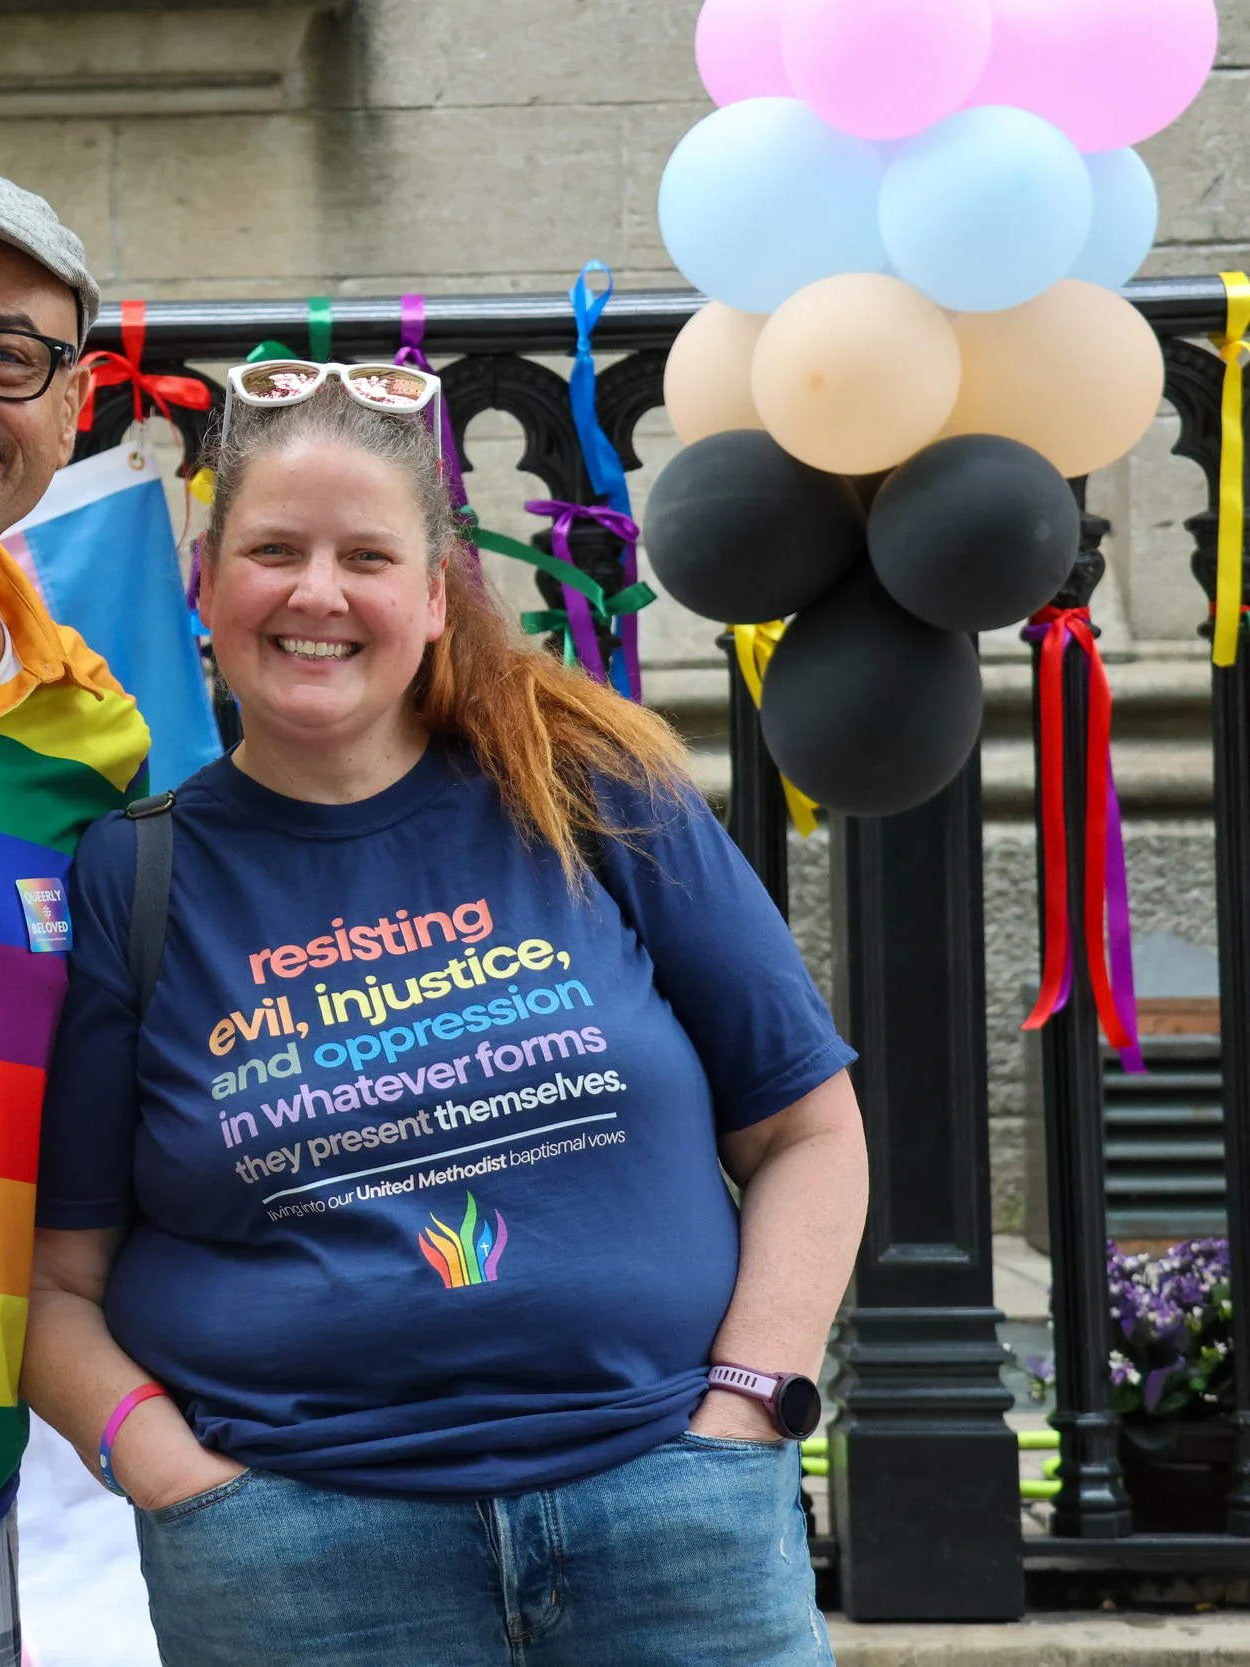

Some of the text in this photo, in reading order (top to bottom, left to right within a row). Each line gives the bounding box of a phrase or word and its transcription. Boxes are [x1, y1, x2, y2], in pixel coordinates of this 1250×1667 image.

[24, 890, 61, 904] QUEERLY
[31, 921, 68, 934] BELOVED
[248, 898, 494, 984] resisting
[208, 938, 571, 1056] evil, injustice,
[211, 977, 595, 1100] and oppression
[219, 1024, 608, 1149] in whatever forms
[235, 1066, 627, 1185] they present themselves.
[267, 1130, 626, 1221] living into our United Methodist baptismal vows
